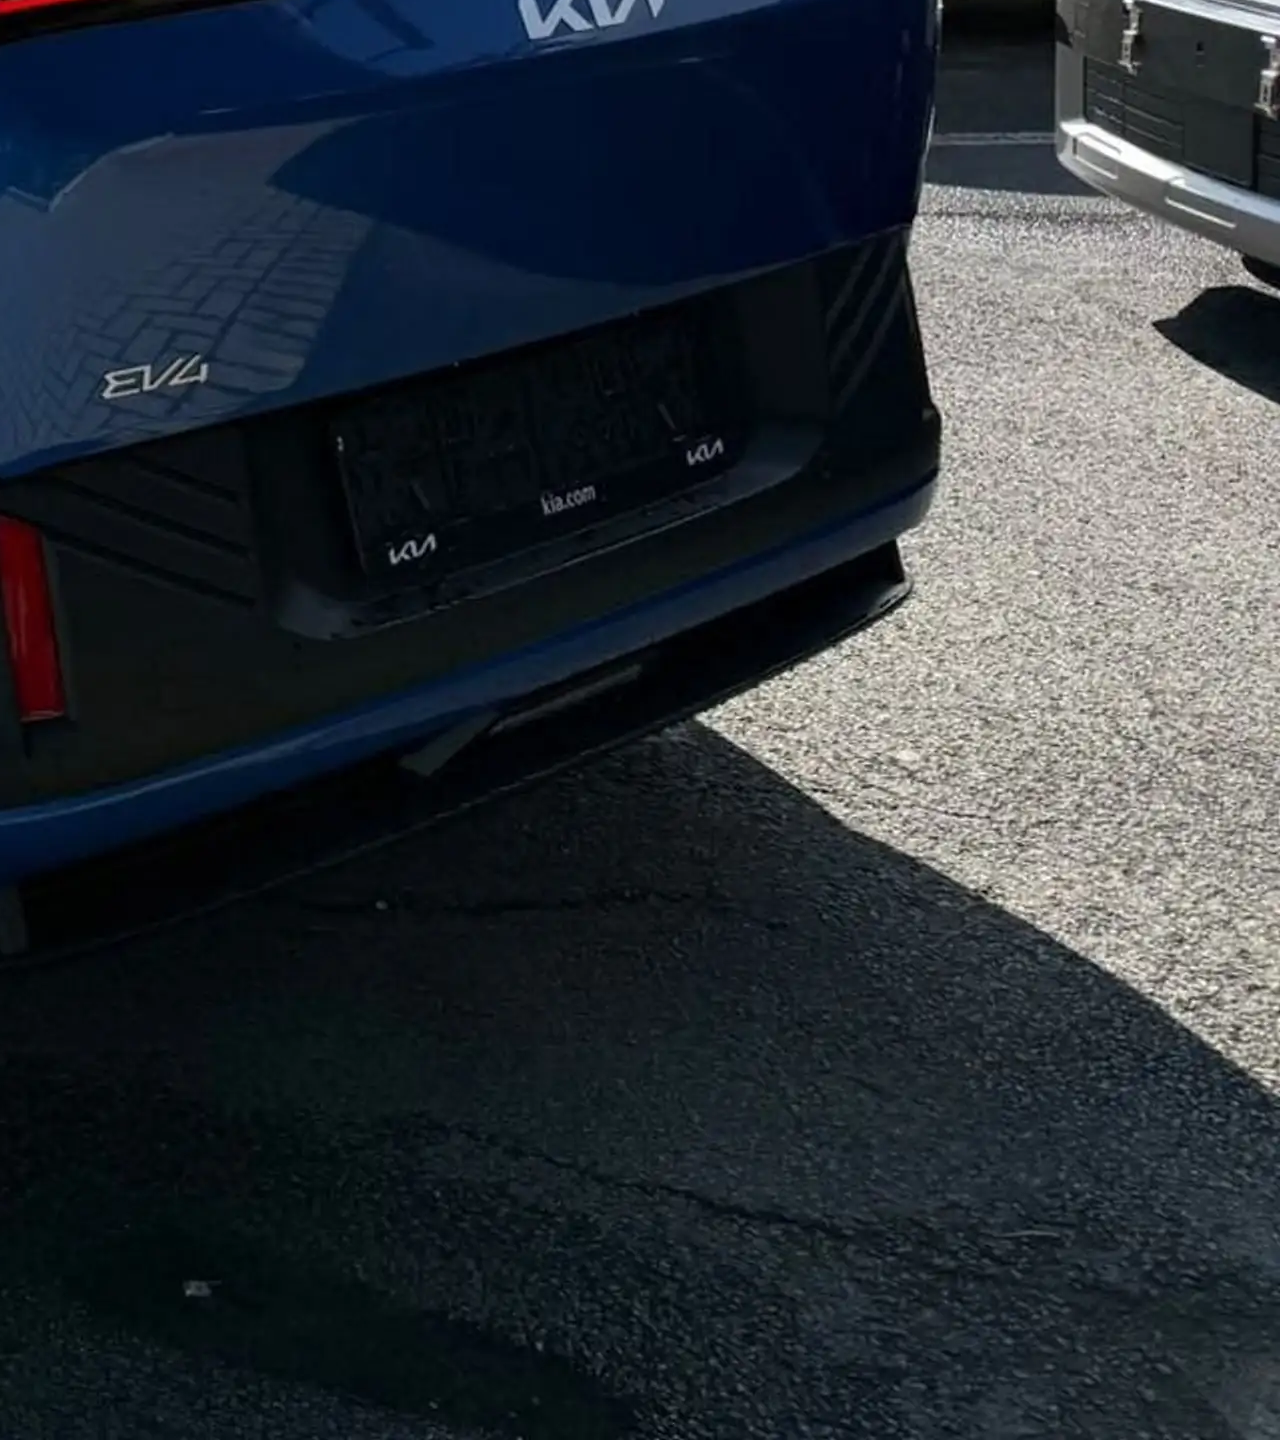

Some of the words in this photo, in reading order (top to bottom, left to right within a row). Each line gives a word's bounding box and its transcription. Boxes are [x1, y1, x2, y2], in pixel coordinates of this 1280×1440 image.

[101, 354, 209, 399] EV4
[686, 438, 725, 465] KIA
[541, 483, 597, 515] kia.com
[388, 533, 437, 564] KIA
